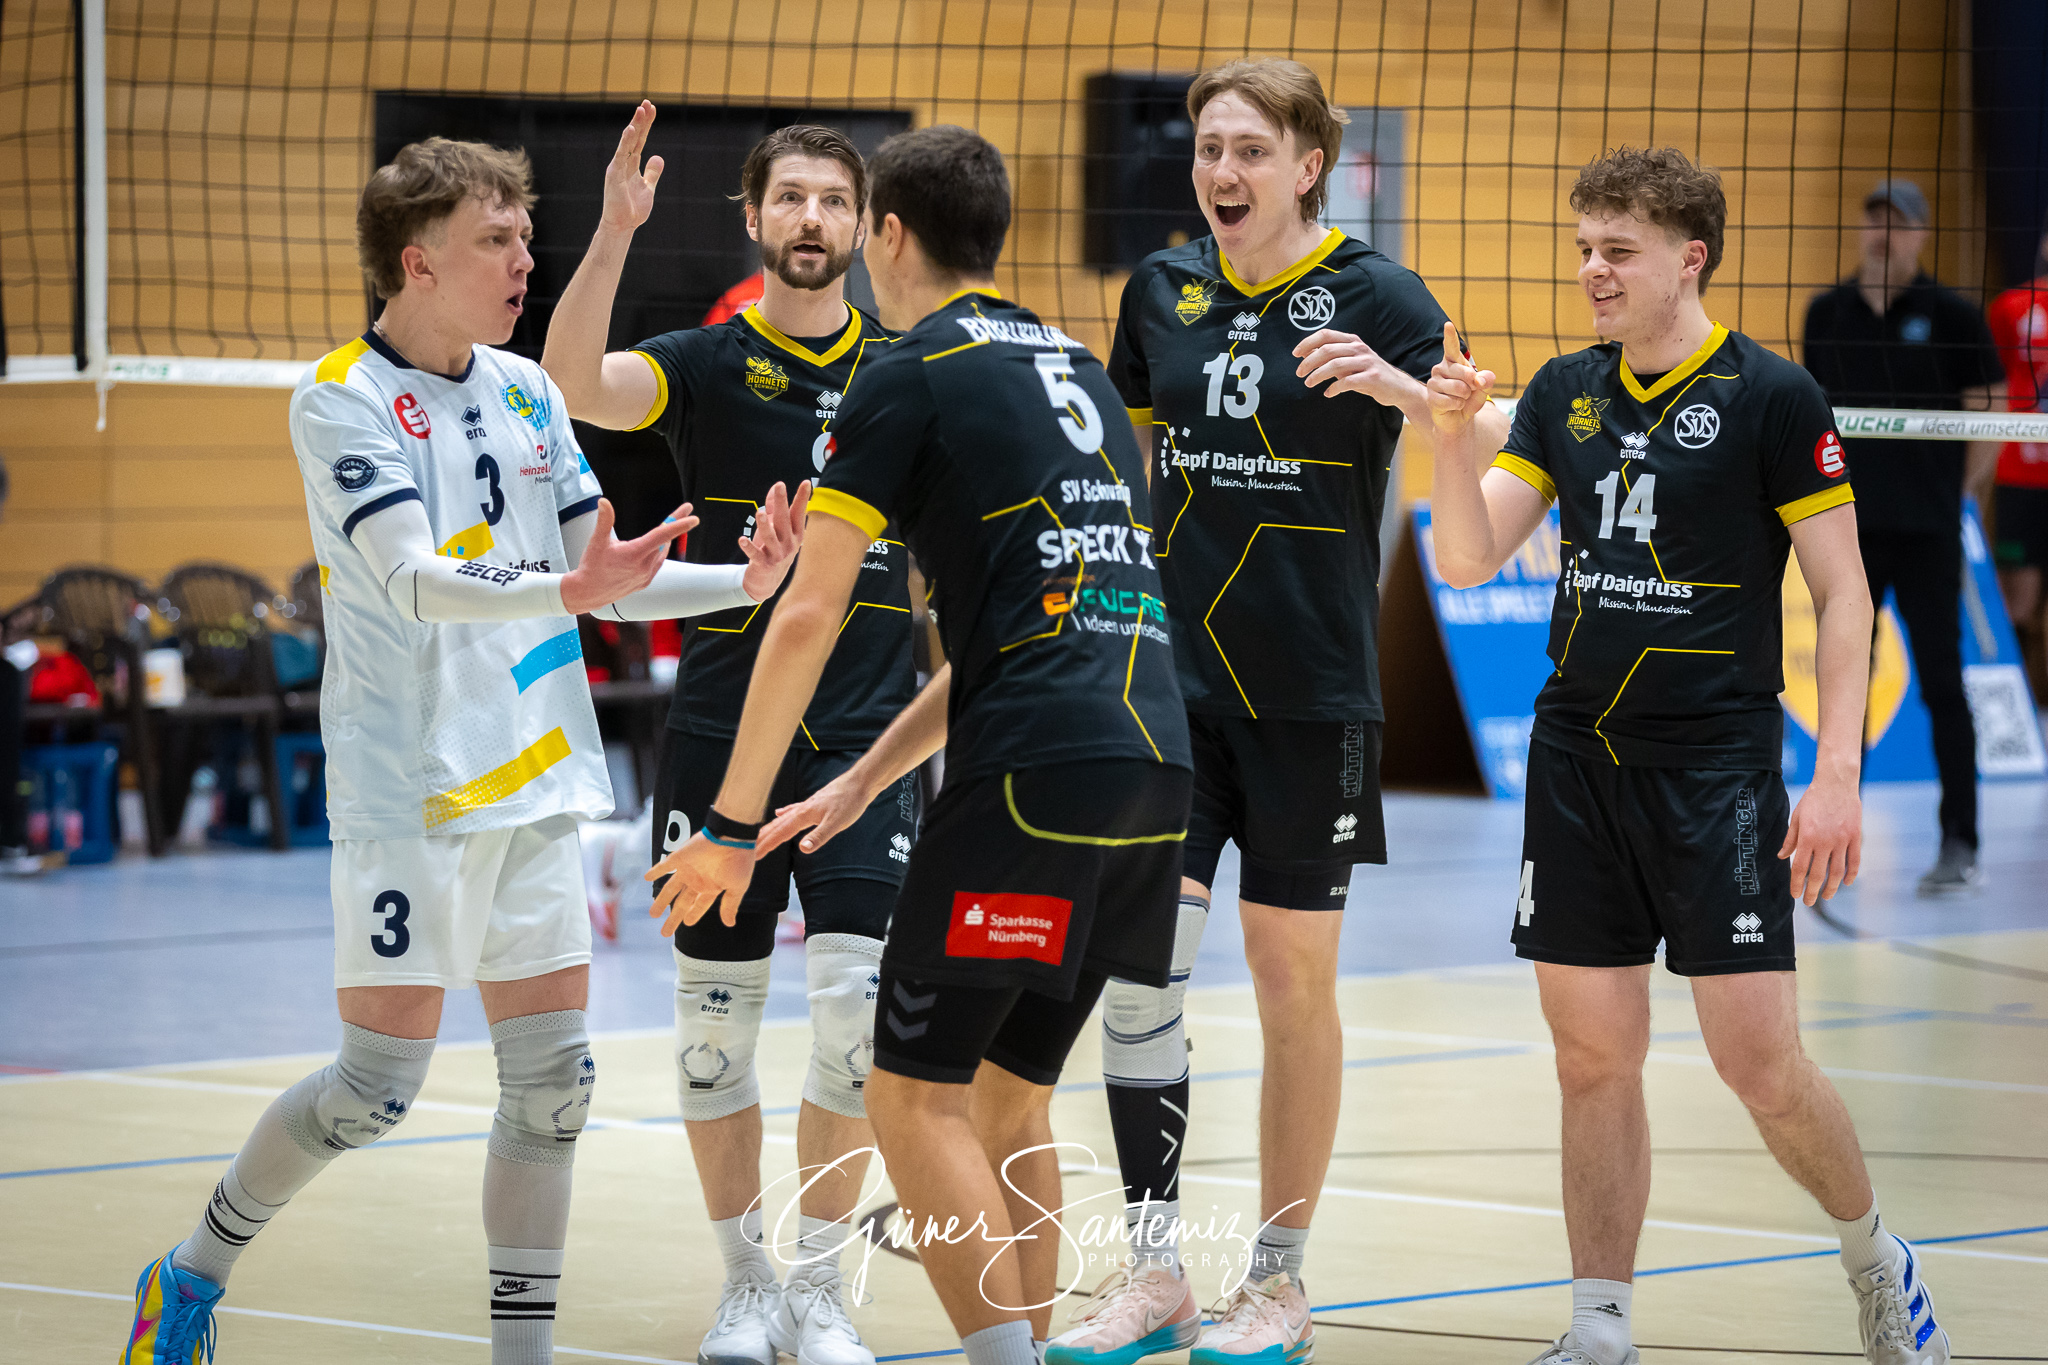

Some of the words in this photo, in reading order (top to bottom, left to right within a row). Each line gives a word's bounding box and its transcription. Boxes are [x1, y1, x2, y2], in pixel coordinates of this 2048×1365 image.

[1227, 329, 1258, 342] errea
[748, 374, 787, 389] HORNETS
[1202, 352, 1265, 419] 13
[1034, 352, 1104, 454] 5
[1568, 416, 1601, 429] HORNETS
[1920, 419, 1966, 435] Ideen
[1171, 449, 1210, 472] Zapf
[1212, 452, 1301, 476] Daigfuss
[1619, 448, 1647, 460] errea
[475, 452, 505, 526] 3
[1060, 479, 1081, 503] SV
[1211, 475, 1247, 489] Mission:
[1594, 470, 1658, 543] 14
[1036, 524, 1133, 569] SPECK
[1572, 569, 1602, 593] Zapf
[1602, 574, 1693, 599] Daigfuss
[1079, 587, 1166, 622] FUCHS
[1598, 596, 1635, 611] Mission:
[1332, 830, 1356, 844] errea
[370, 889, 411, 958] 3
[989, 913, 1054, 931] Sparkasse
[987, 929, 1047, 948] Nürnberg
[1731, 931, 1765, 944] errea
[700, 1003, 730, 1015] errea
[499, 1278, 531, 1291] NIKE
